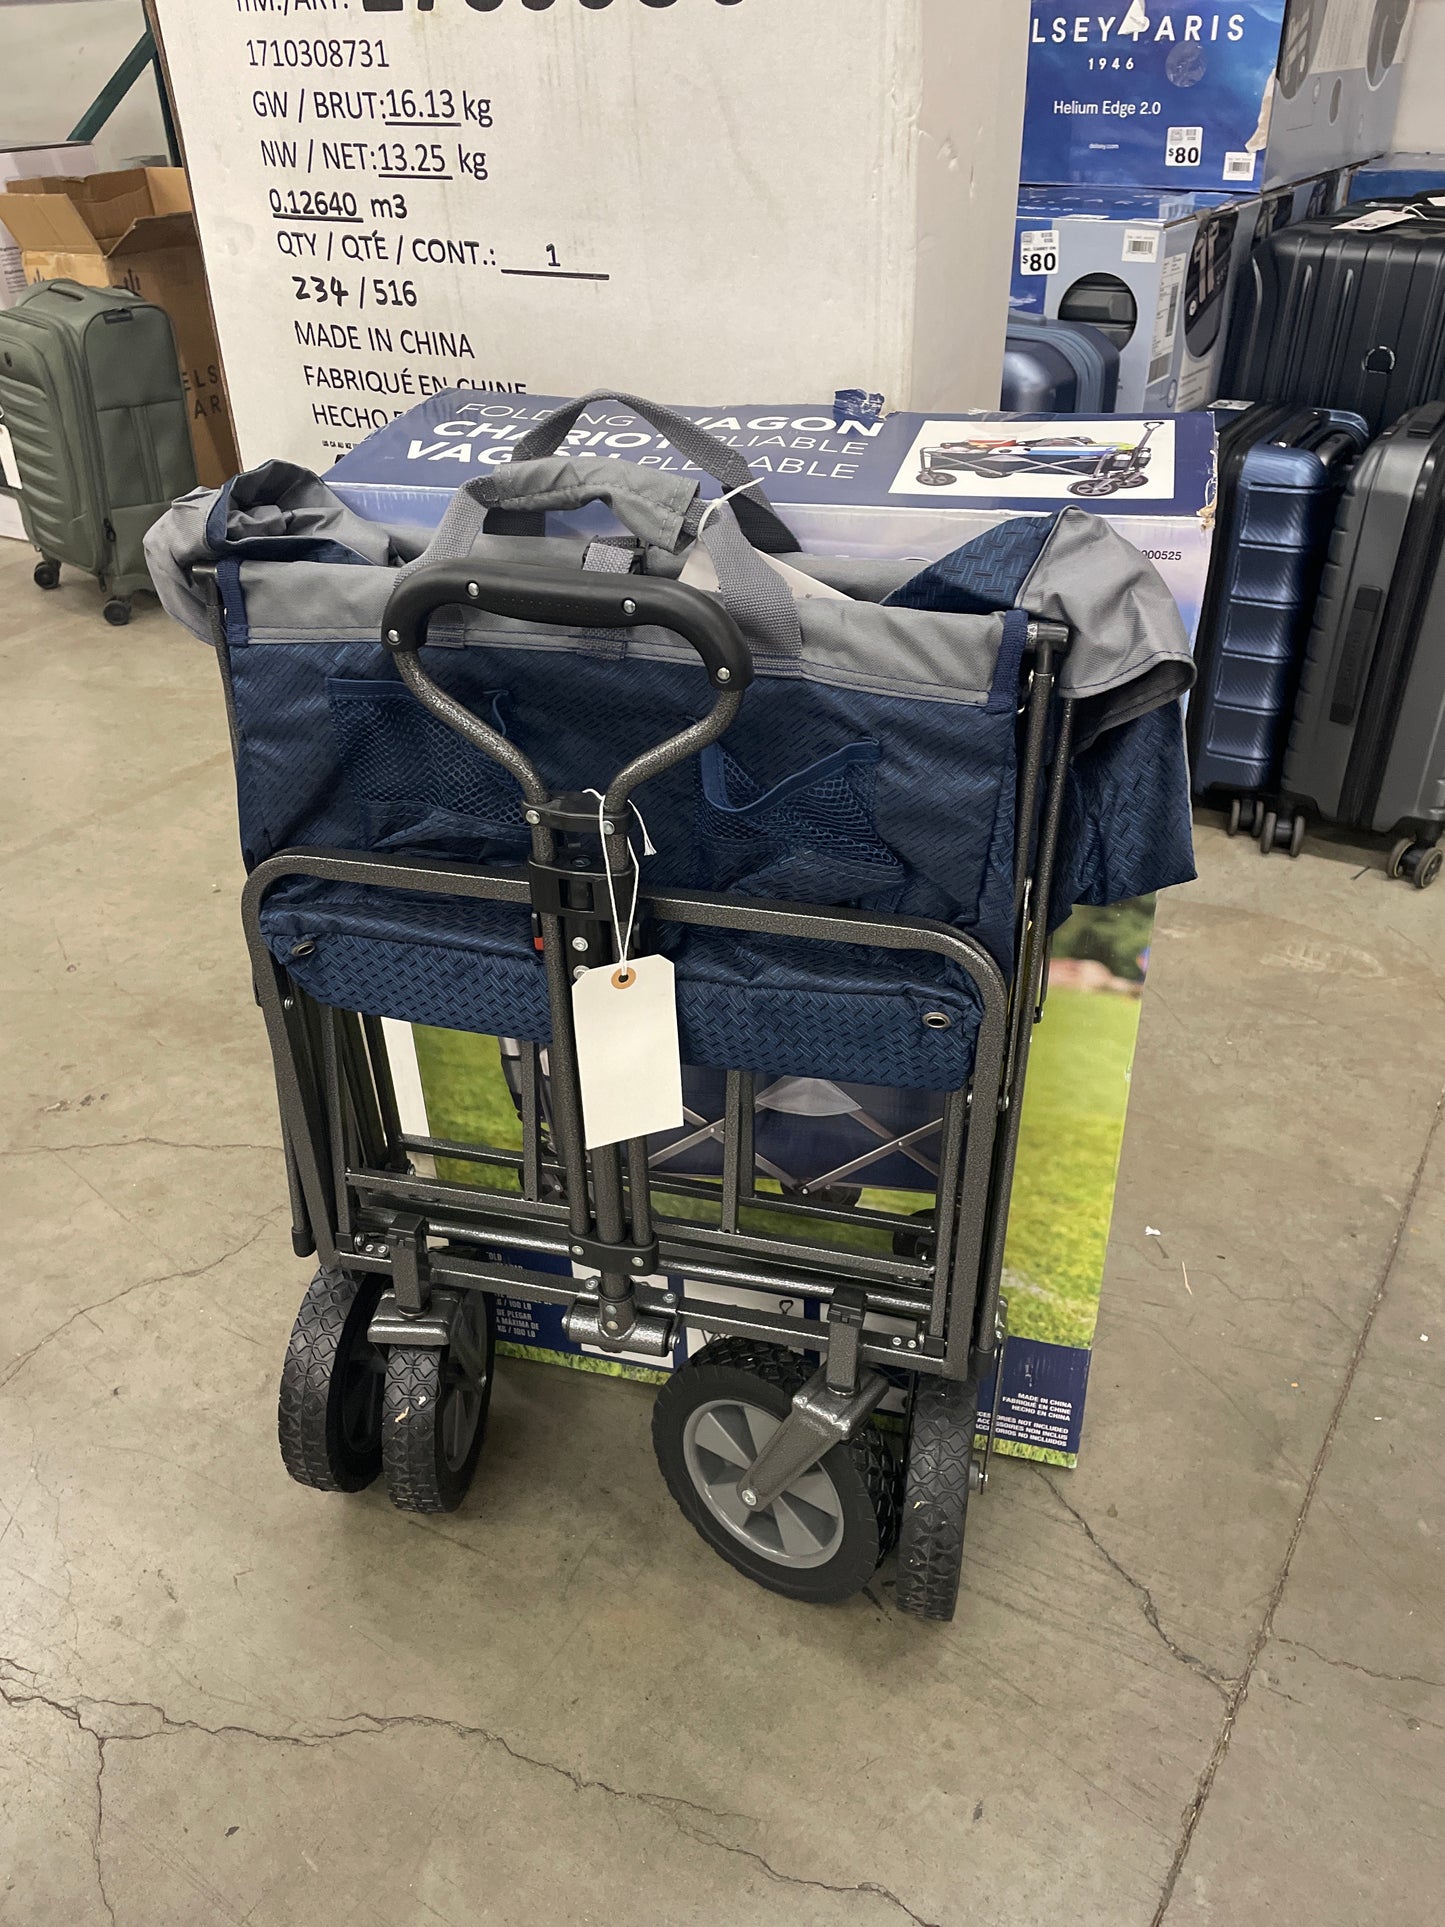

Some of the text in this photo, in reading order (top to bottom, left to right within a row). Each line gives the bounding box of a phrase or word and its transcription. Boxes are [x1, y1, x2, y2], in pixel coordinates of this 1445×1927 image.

[246, 40, 390, 67] 1710308731
[1088, 57, 1135, 70] 1946
[252, 91, 288, 118] GW
[298, 88, 305, 123] /
[462, 91, 493, 127] kg
[1053, 100, 1162, 118] Helium Edge 2.0
[261, 139, 297, 168] NW
[307, 139, 314, 173] /
[457, 144, 489, 180] kg
[1168, 147, 1199, 164] $80
[269, 188, 408, 219] 0.12640 m3
[277, 230, 561, 267] QTY / QTÉ / CONT.: 1
[1022, 252, 1056, 271] $80
[291, 276, 418, 309] 234 / 516
[294, 320, 475, 359] MADE IN CHINA
[303, 365, 415, 396] FABRIQUÉ
[418, 374, 448, 396] EN
[311, 403, 389, 430] HECHO
[456, 403, 637, 427] FOLDNG
[1002, 1396, 1071, 1415] FABRIQUÉ EN CHINE
[1017, 1393, 1039, 1403] MADE
[1049, 1399, 1073, 1409] CHINA
[1011, 1404, 1036, 1414] HECHO
[1047, 1412, 1071, 1421] CHINA
[1017, 1418, 1032, 1427] NOT
[1033, 1421, 1069, 1434] INCLUDED
[1025, 1427, 1041, 1436] NON
[1041, 1429, 1068, 1441] INCLUS
[1029, 1433, 1068, 1447] INCLUIDOS
